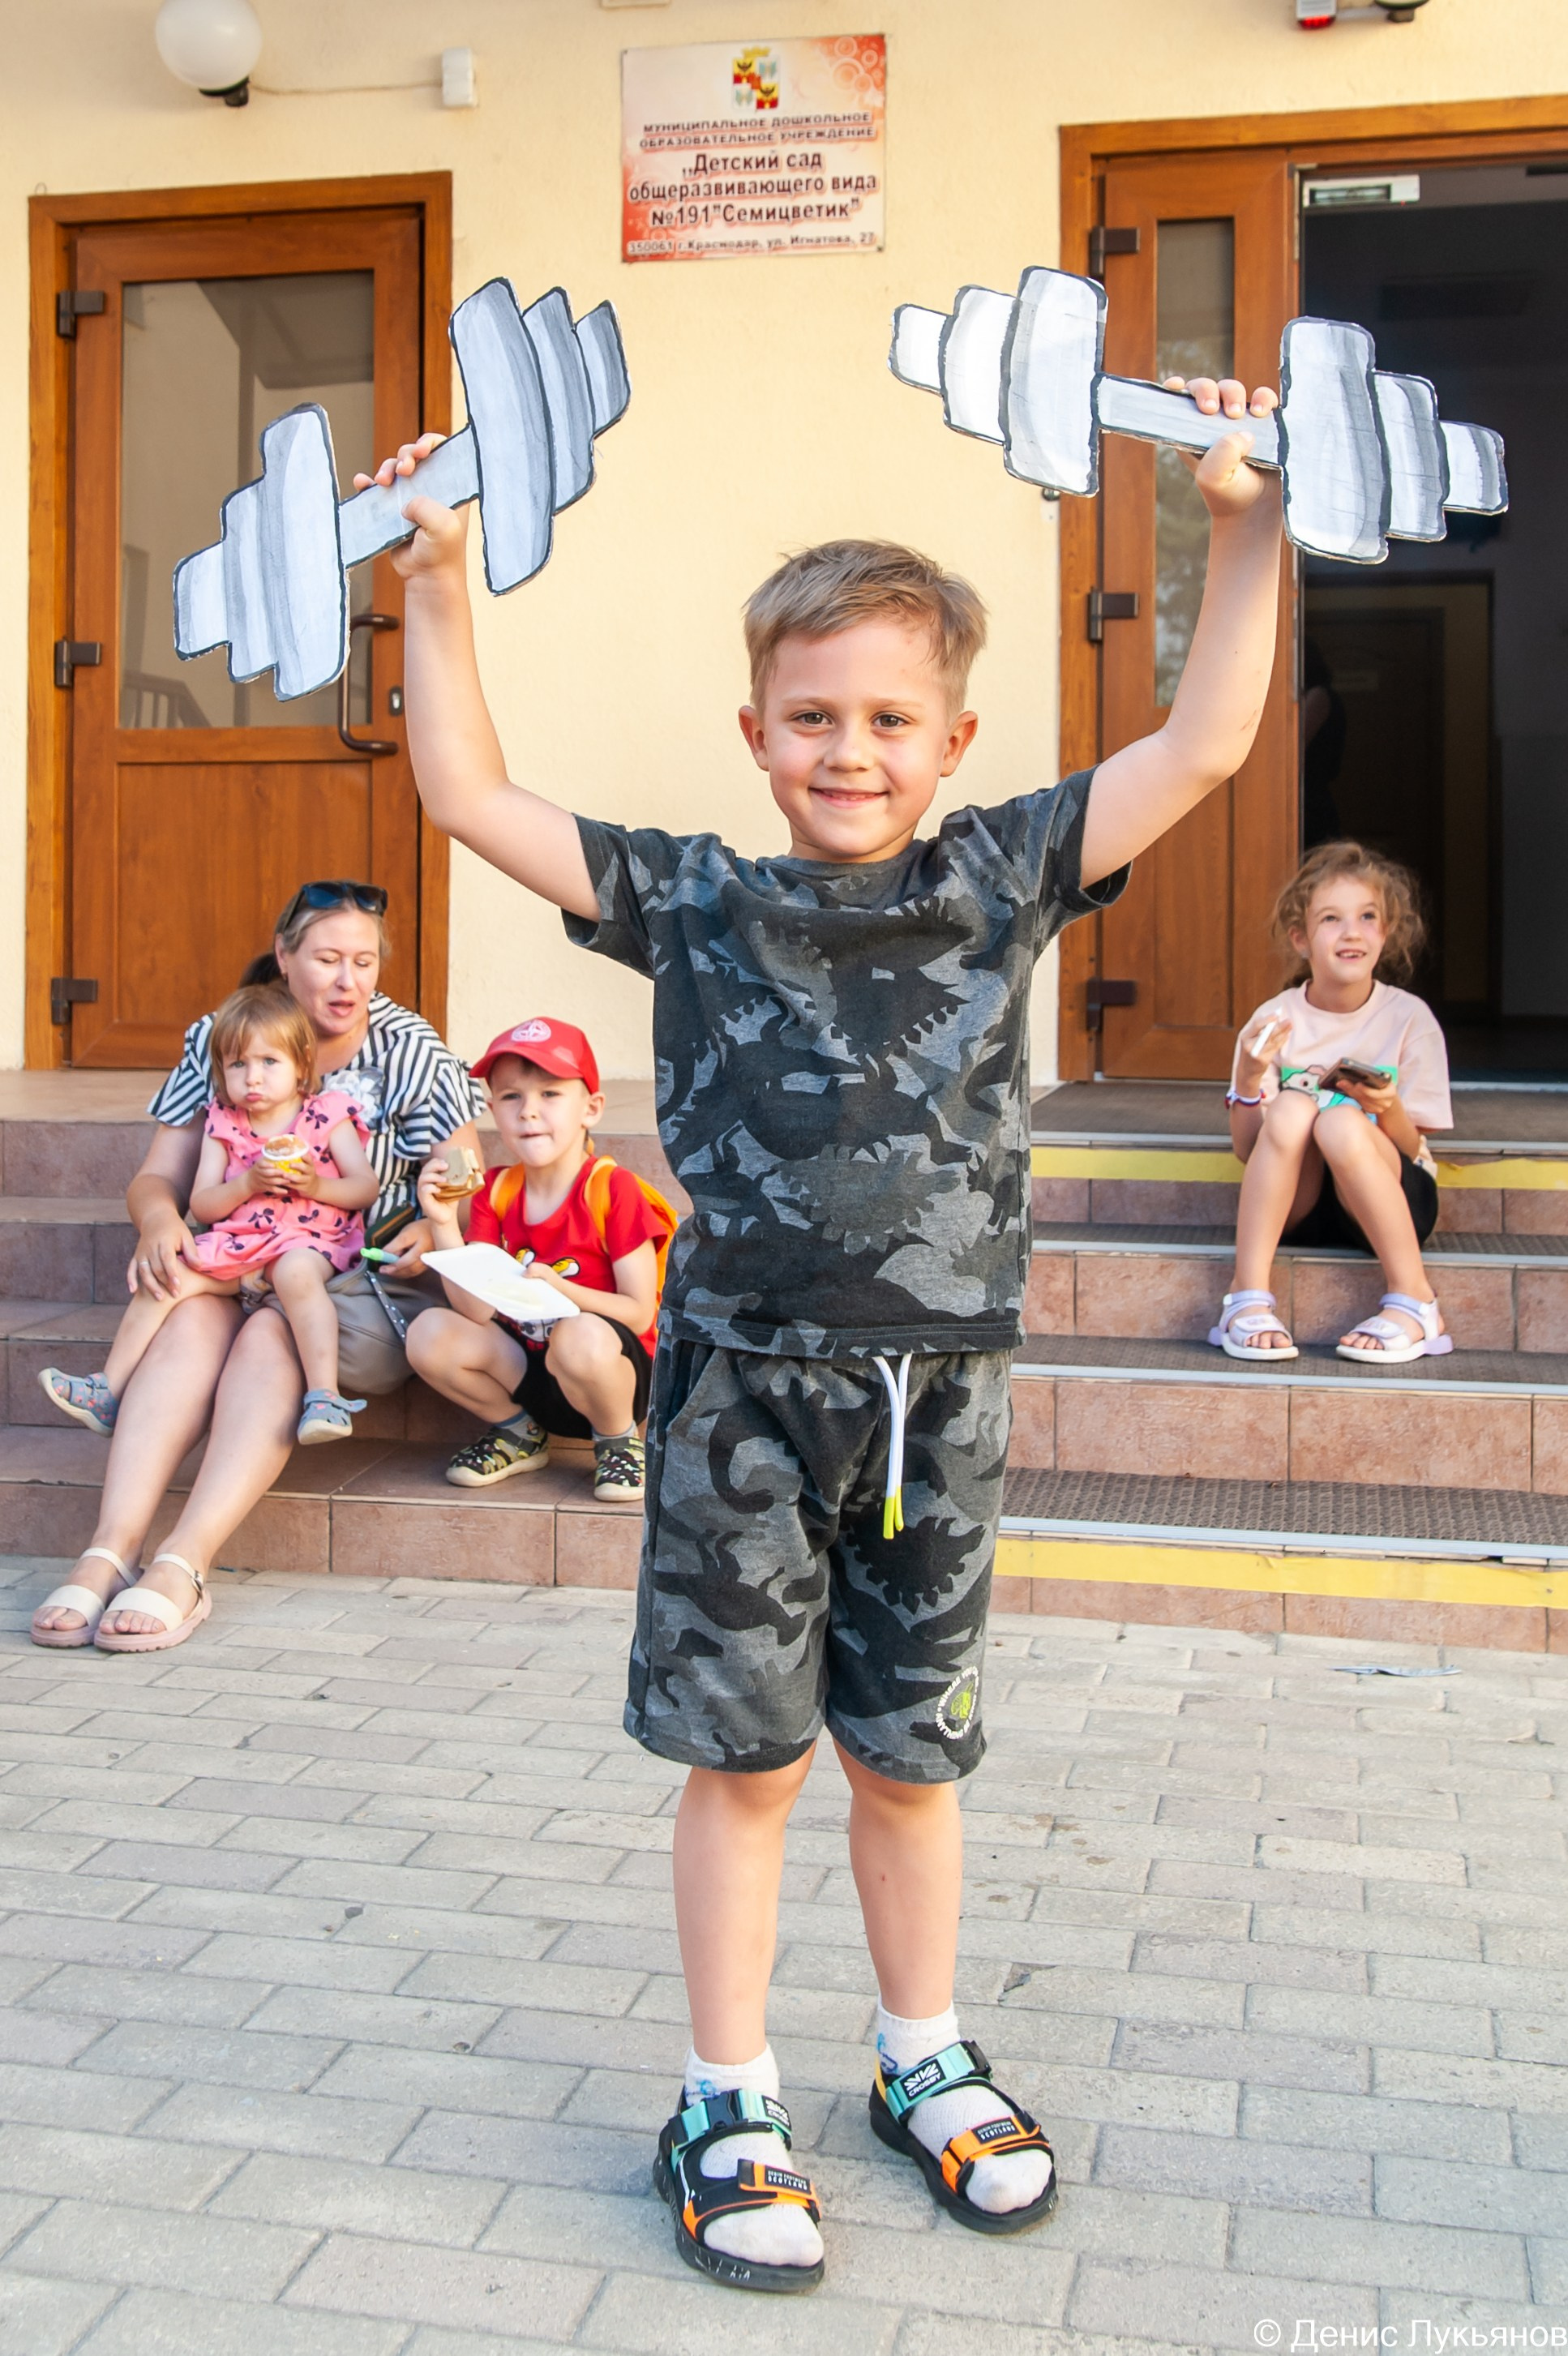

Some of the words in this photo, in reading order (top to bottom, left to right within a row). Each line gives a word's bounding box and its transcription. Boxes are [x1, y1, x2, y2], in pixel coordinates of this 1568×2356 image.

[644, 118, 766, 132] МУНИЦИПАЛЬНОЕ
[772, 112, 870, 126] ДОШКОЛЬНОЕ
[640, 132, 774, 148] ОБРАЗОВАТЕЛЬНОЕ
[781, 128, 873, 139] УЧРЕЖДЕНИЕ
[786, 152, 821, 169] сад
[630, 176, 824, 201] общеразвивающего
[832, 175, 876, 191] вида
[909, 2072, 940, 2097] CROSBY
